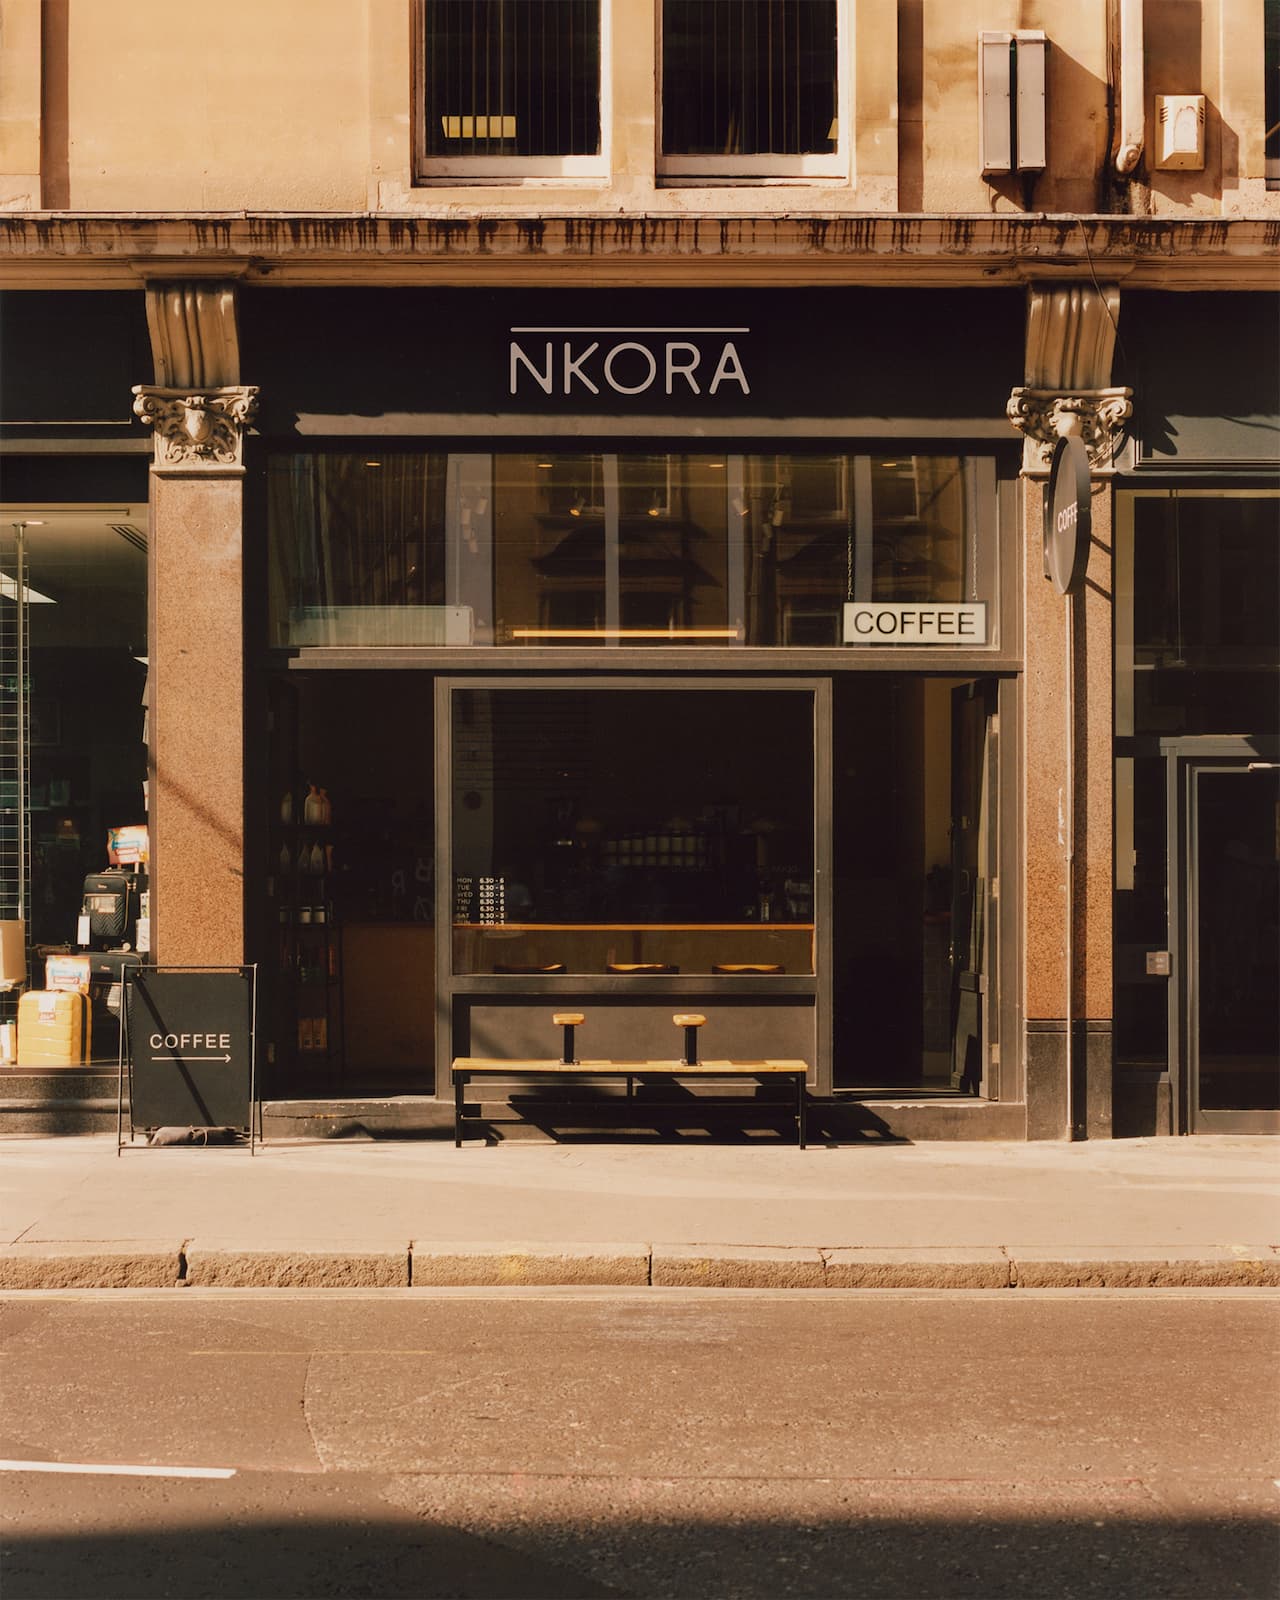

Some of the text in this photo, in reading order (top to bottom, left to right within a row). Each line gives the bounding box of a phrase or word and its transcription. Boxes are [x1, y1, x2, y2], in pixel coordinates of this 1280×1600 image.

[509, 341, 751, 396] NKORA
[853, 611, 976, 636] COFFEE
[149, 1032, 232, 1050] COFFEE
